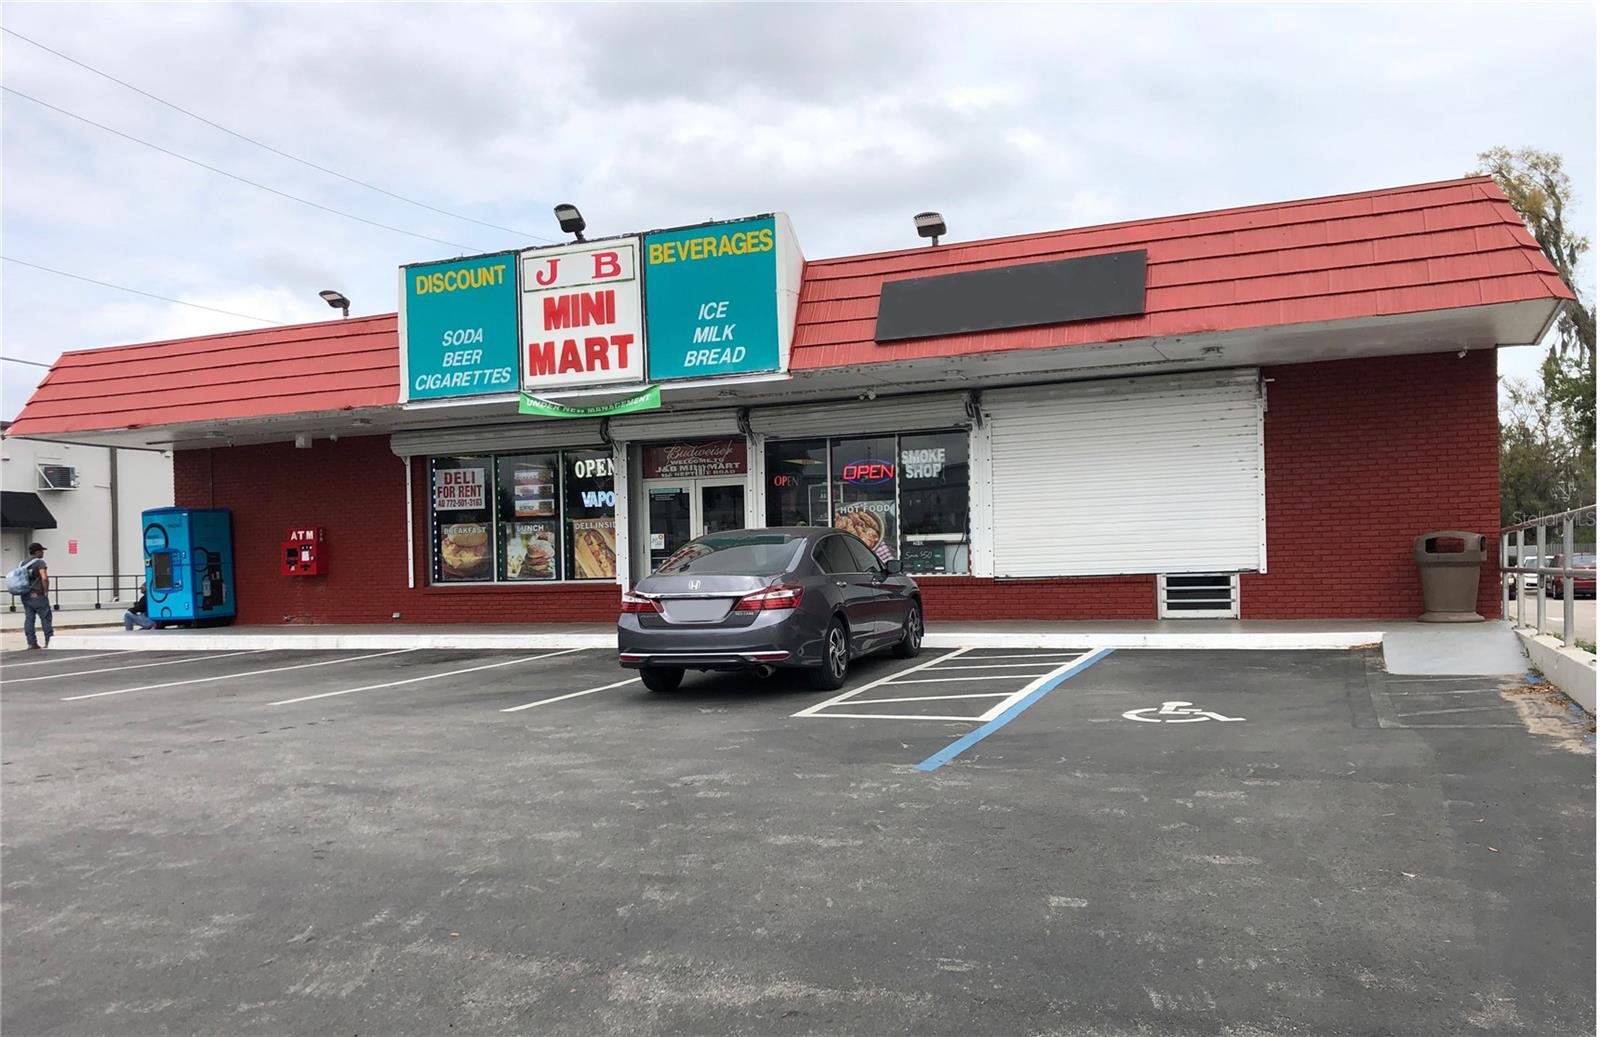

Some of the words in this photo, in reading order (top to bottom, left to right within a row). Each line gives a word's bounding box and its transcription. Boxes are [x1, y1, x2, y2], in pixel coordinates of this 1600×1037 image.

[649, 229, 774, 265] BEVERAGES
[536, 258, 561, 286] J
[591, 251, 622, 279] B
[416, 264, 505, 295] DISCOUNT
[543, 290, 616, 331] MINI
[698, 301, 729, 320] ICE
[442, 328, 484, 347] SODA
[693, 324, 735, 344] MILK
[443, 349, 483, 368] BEER
[529, 335, 634, 377] MART
[684, 346, 746, 368] BREAD
[415, 367, 512, 392] CIGARETTES
[526, 397, 560, 412] UNDER
[587, 394, 651, 414] MANAGEMENT
[664, 440, 733, 461] Budweiser
[901, 448, 945, 465] SMOKE
[575, 458, 616, 479] OPEN
[706, 462, 741, 470] MART
[843, 464, 894, 480] OPEN
[905, 462, 942, 479] SHOP
[443, 471, 475, 485] DELI
[774, 475, 799, 487] OPEN
[437, 486, 456, 499] FOR
[458, 484, 482, 498] RENT
[841, 505, 860, 514] HOT
[862, 503, 890, 513] FOOD
[291, 530, 314, 541] ATM
[444, 527, 487, 535] BREAKFAST
[516, 523, 545, 533] LUNCH
[575, 522, 592, 530] DELI
